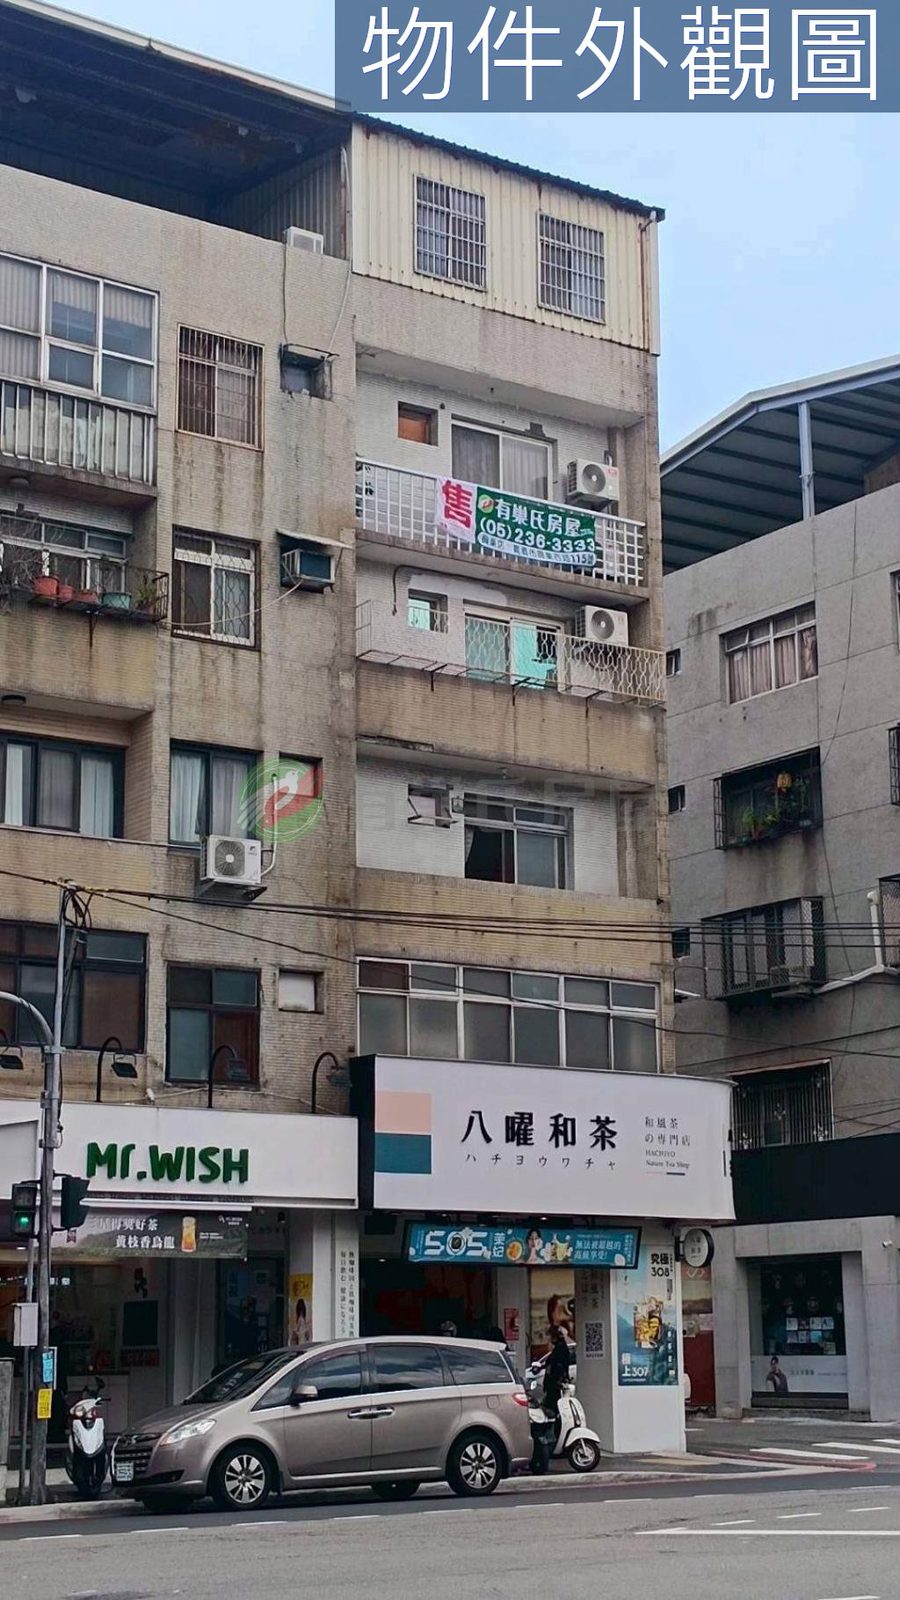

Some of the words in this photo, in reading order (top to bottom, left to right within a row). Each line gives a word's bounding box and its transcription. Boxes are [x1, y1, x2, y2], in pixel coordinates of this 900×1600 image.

[442, 480, 473, 528] 售
[496, 499, 580, 536] 有巢氏房屋
[480, 517, 595, 552] (05)236-3333
[461, 1110, 617, 1151] 八曜和茶
[86, 1142, 249, 1184] Mr.WISH
[650, 1253, 669, 1265] 究極
[650, 1267, 670, 1277] 308
